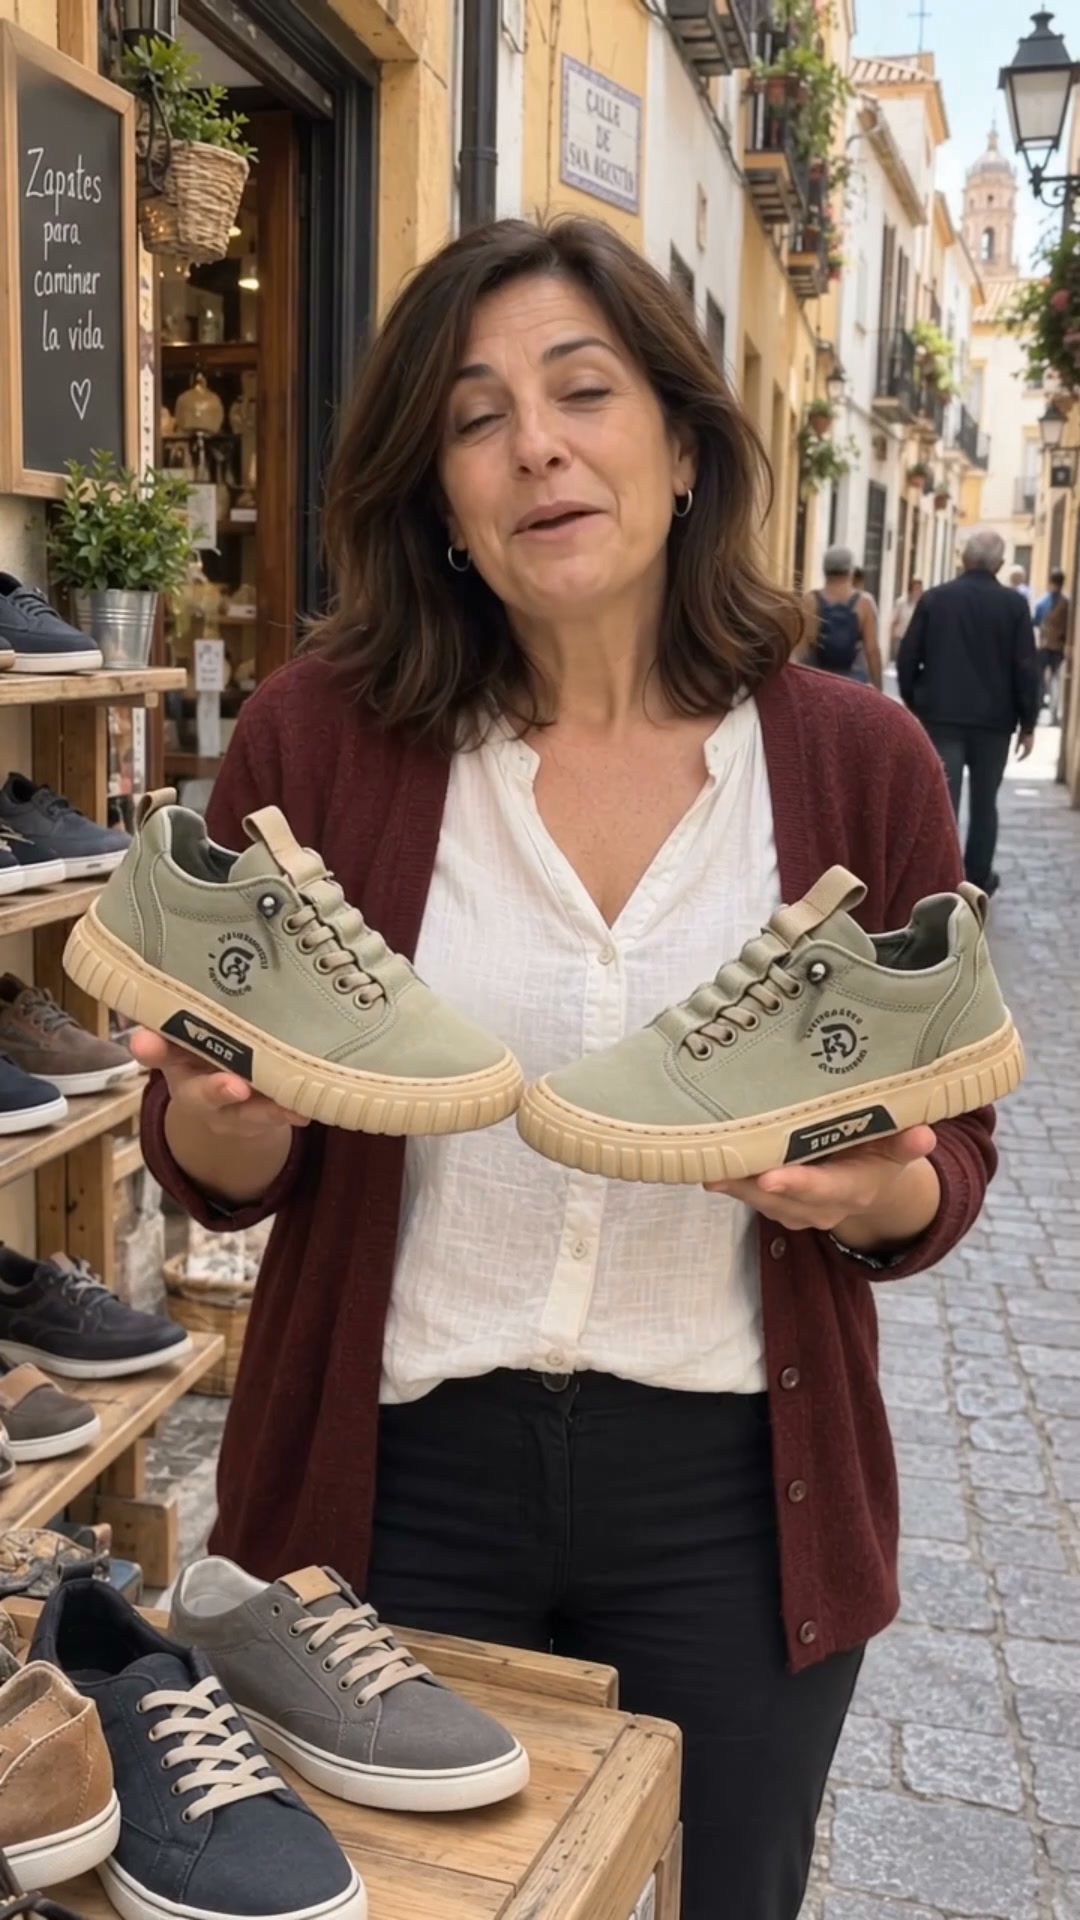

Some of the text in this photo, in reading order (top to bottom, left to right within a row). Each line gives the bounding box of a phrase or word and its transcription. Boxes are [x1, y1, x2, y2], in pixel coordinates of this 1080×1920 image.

[586, 88, 620, 127] CALLE
[569, 142, 590, 172] SAN
[596, 125, 610, 153] DE
[44, 221, 81, 261] para
[43, 309, 104, 351] la vida
